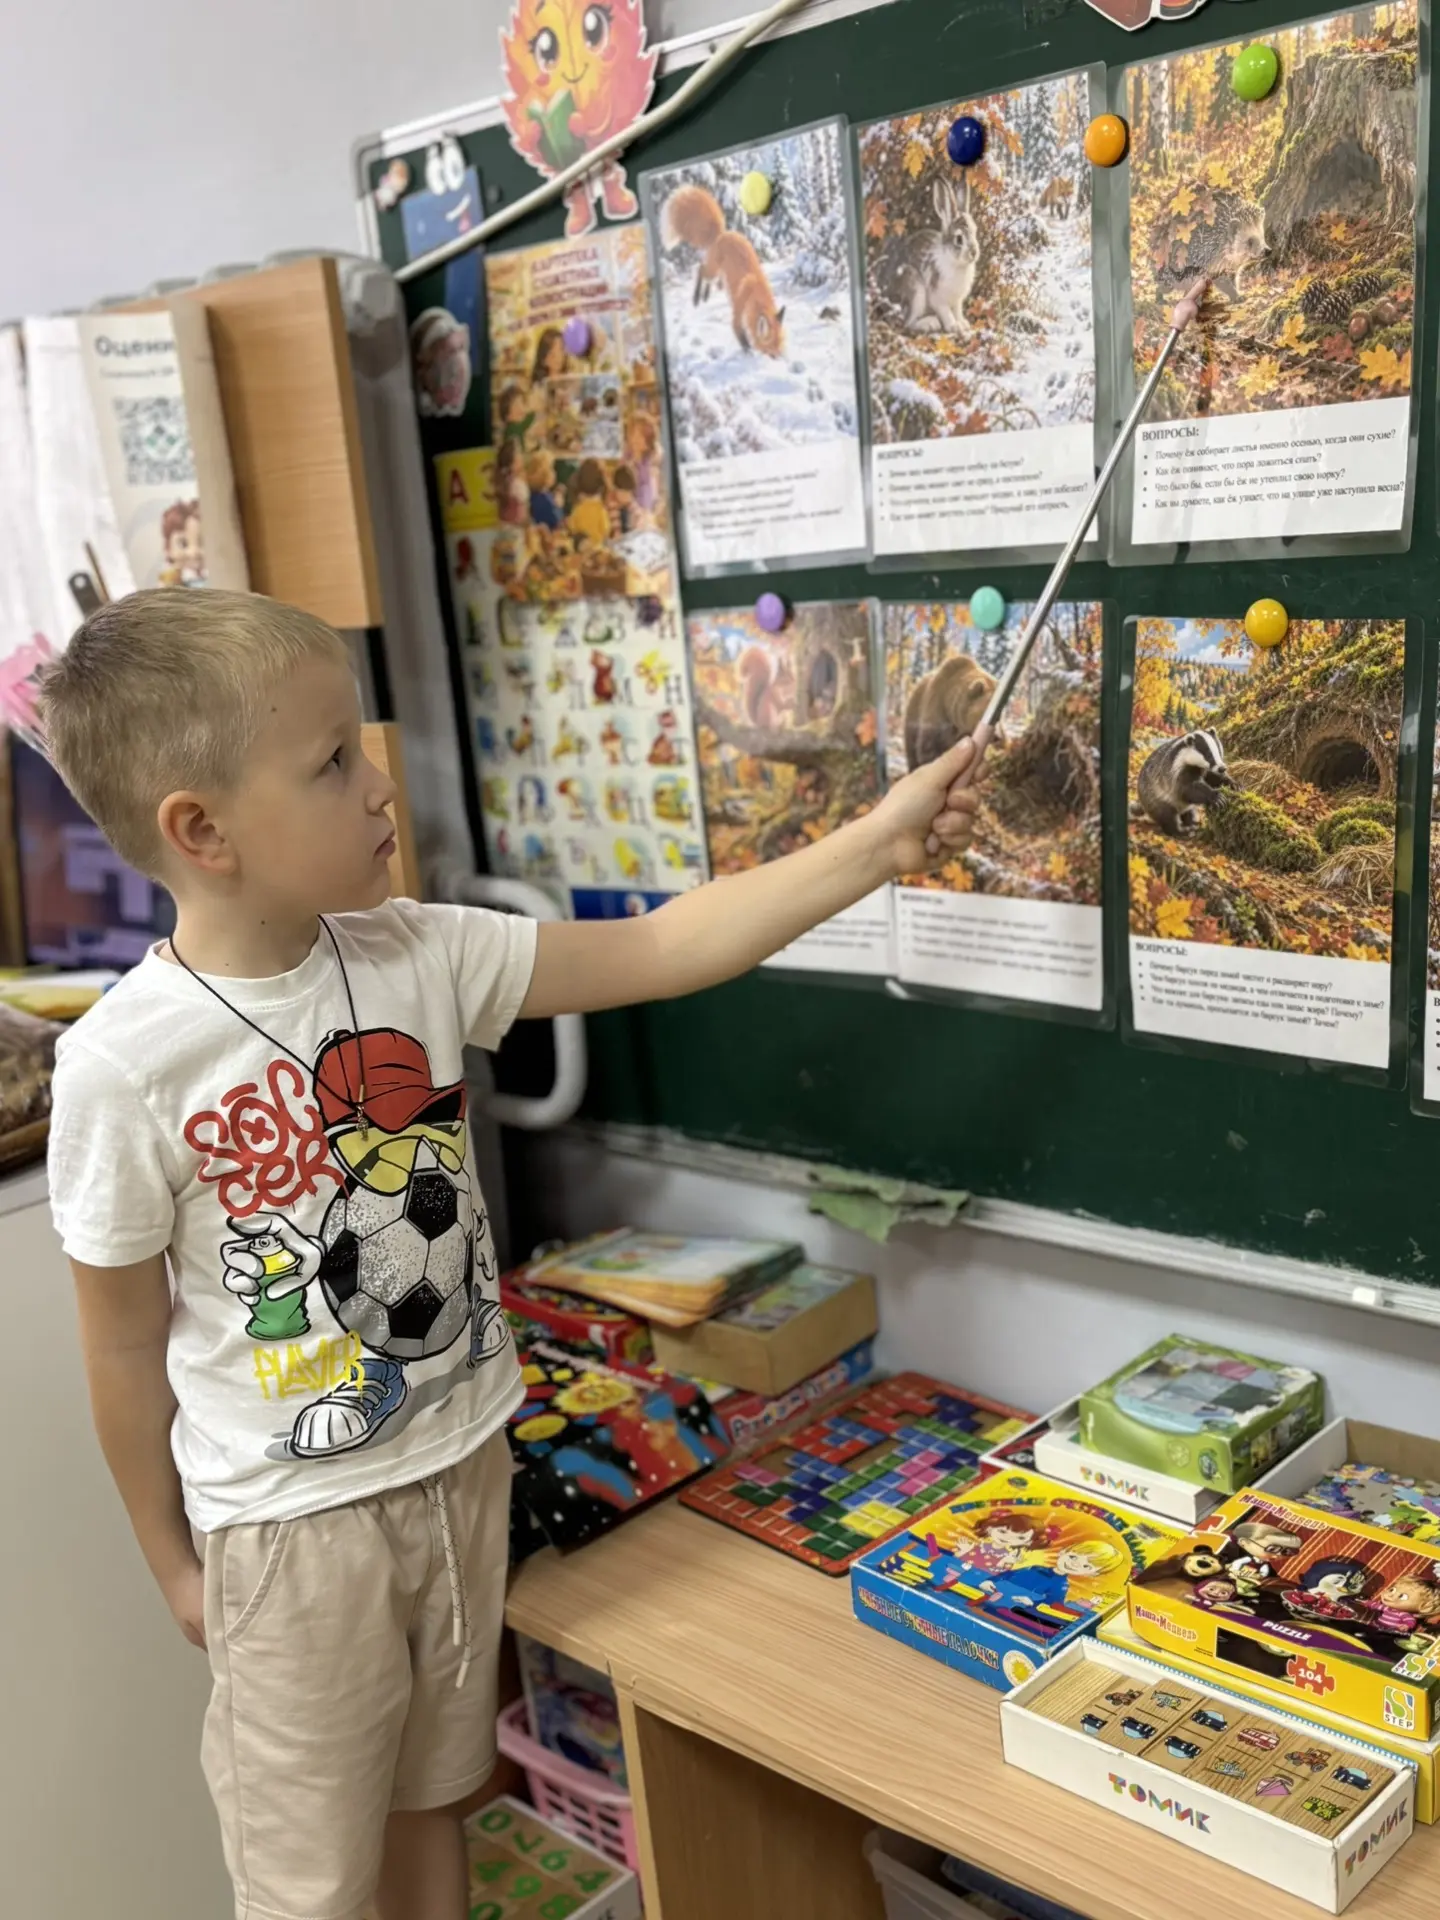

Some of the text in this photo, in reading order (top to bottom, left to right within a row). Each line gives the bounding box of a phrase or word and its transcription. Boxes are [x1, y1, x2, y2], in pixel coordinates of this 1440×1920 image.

[1142, 426, 1199, 441] ВОПРОСЫ:
[1155, 447, 1182, 463] Почему
[1196, 444, 1229, 458] собирает
[1231, 443, 1256, 453] листья
[1259, 441, 1288, 451] именно
[1290, 437, 1322, 448] осенью,
[1324, 435, 1346, 444] когда
[1349, 433, 1364, 442] они
[1367, 427, 1395, 443] сухие?
[1080, 1466, 1149, 1501] ТОМИК
[1240, 1494, 1273, 1511] Маша
[1274, 1507, 1328, 1530] Медведь
[1135, 1605, 1156, 1622] Маша
[1159, 1615, 1197, 1641] Медведь
[1262, 1620, 1312, 1641] PUZZLE
[1298, 1668, 1323, 1684] 104
[1394, 1667, 1422, 1679] STEP
[1385, 1713, 1413, 1728] STEP
[1108, 1772, 1211, 1834] ТОМИК
[1345, 1797, 1407, 1878] ТОМИК
